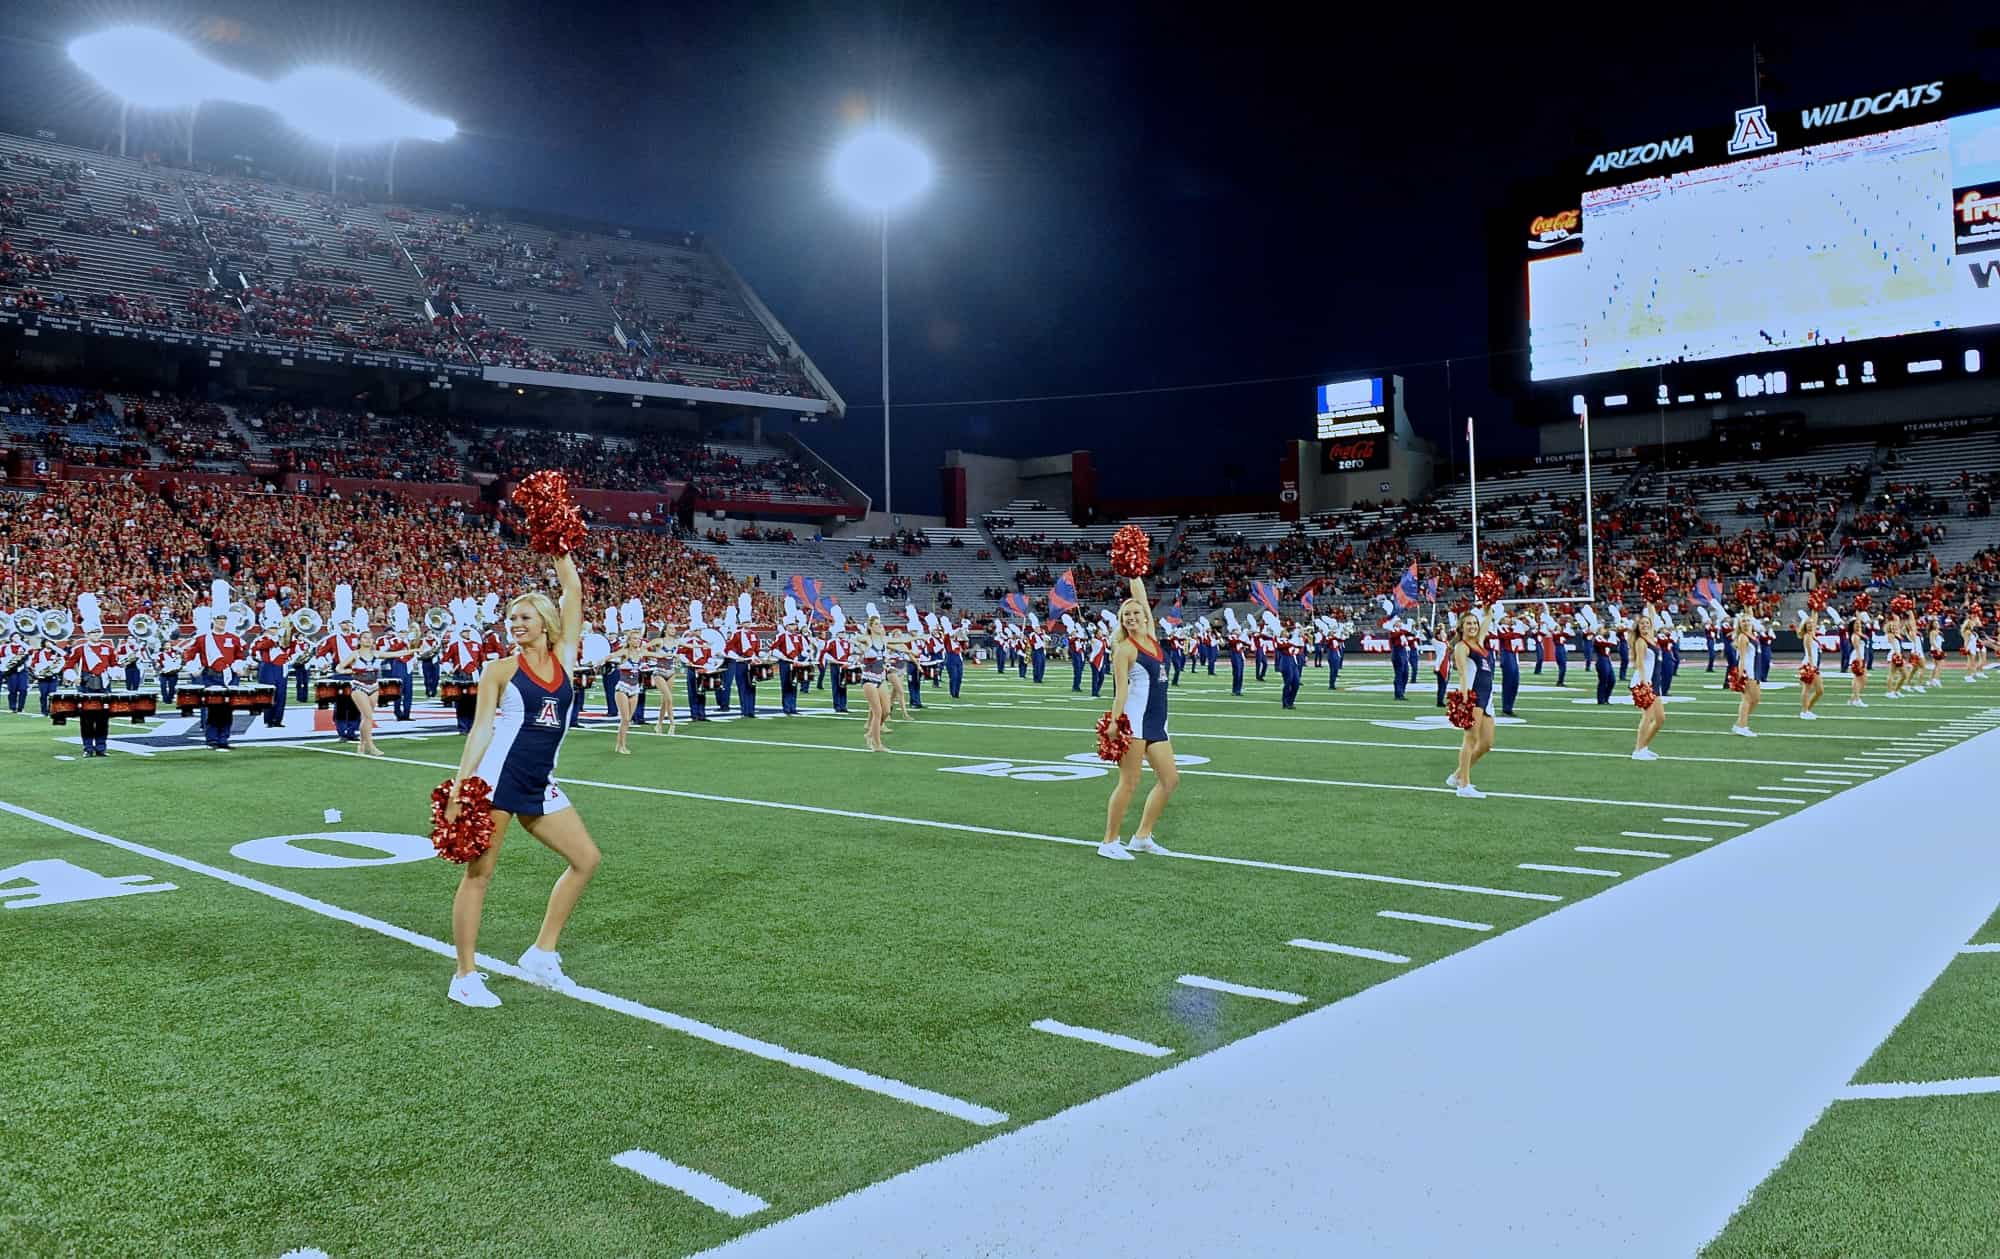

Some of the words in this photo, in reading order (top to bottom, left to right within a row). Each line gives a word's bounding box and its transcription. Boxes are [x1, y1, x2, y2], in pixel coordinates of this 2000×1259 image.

[1801, 81, 1943, 129] WILDCATS
[1728, 105, 1777, 155] A
[1585, 135, 1694, 175] ARIZONA
[1338, 459, 1365, 470] zero
[535, 697, 561, 728] A
